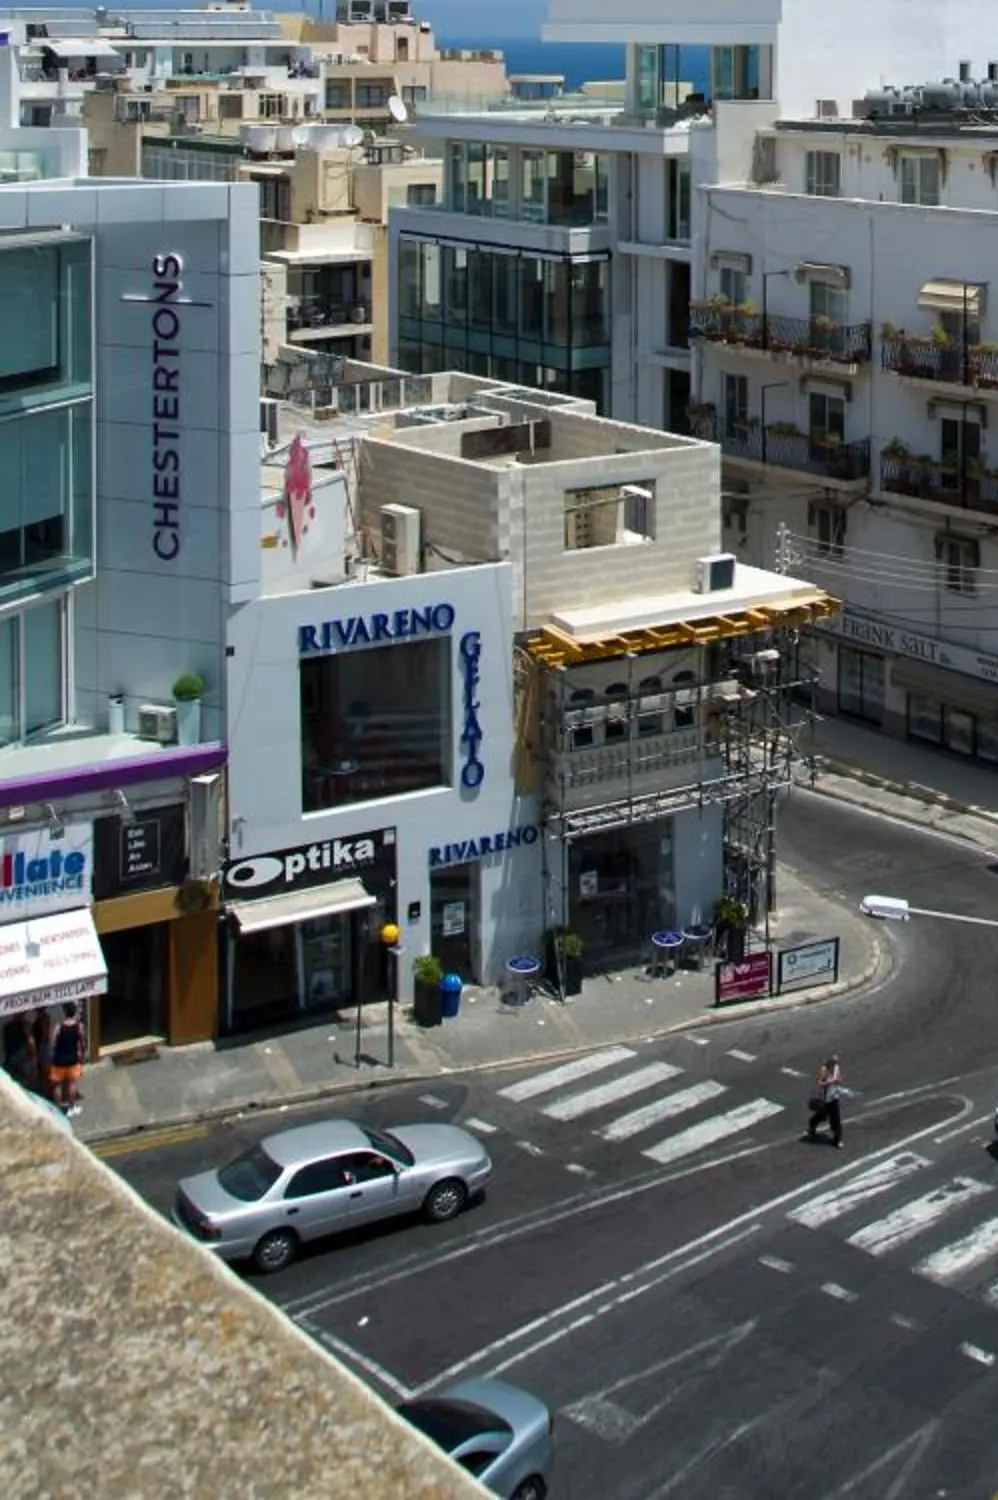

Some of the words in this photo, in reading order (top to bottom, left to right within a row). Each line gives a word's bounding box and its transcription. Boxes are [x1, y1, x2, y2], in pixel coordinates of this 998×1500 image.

[153, 255, 180, 561] CHESTERTONS
[298, 603, 455, 651] RIVARENO
[460, 631, 485, 787] GELATO
[226, 838, 375, 889] Optika
[429, 825, 539, 866] RIVARENO
